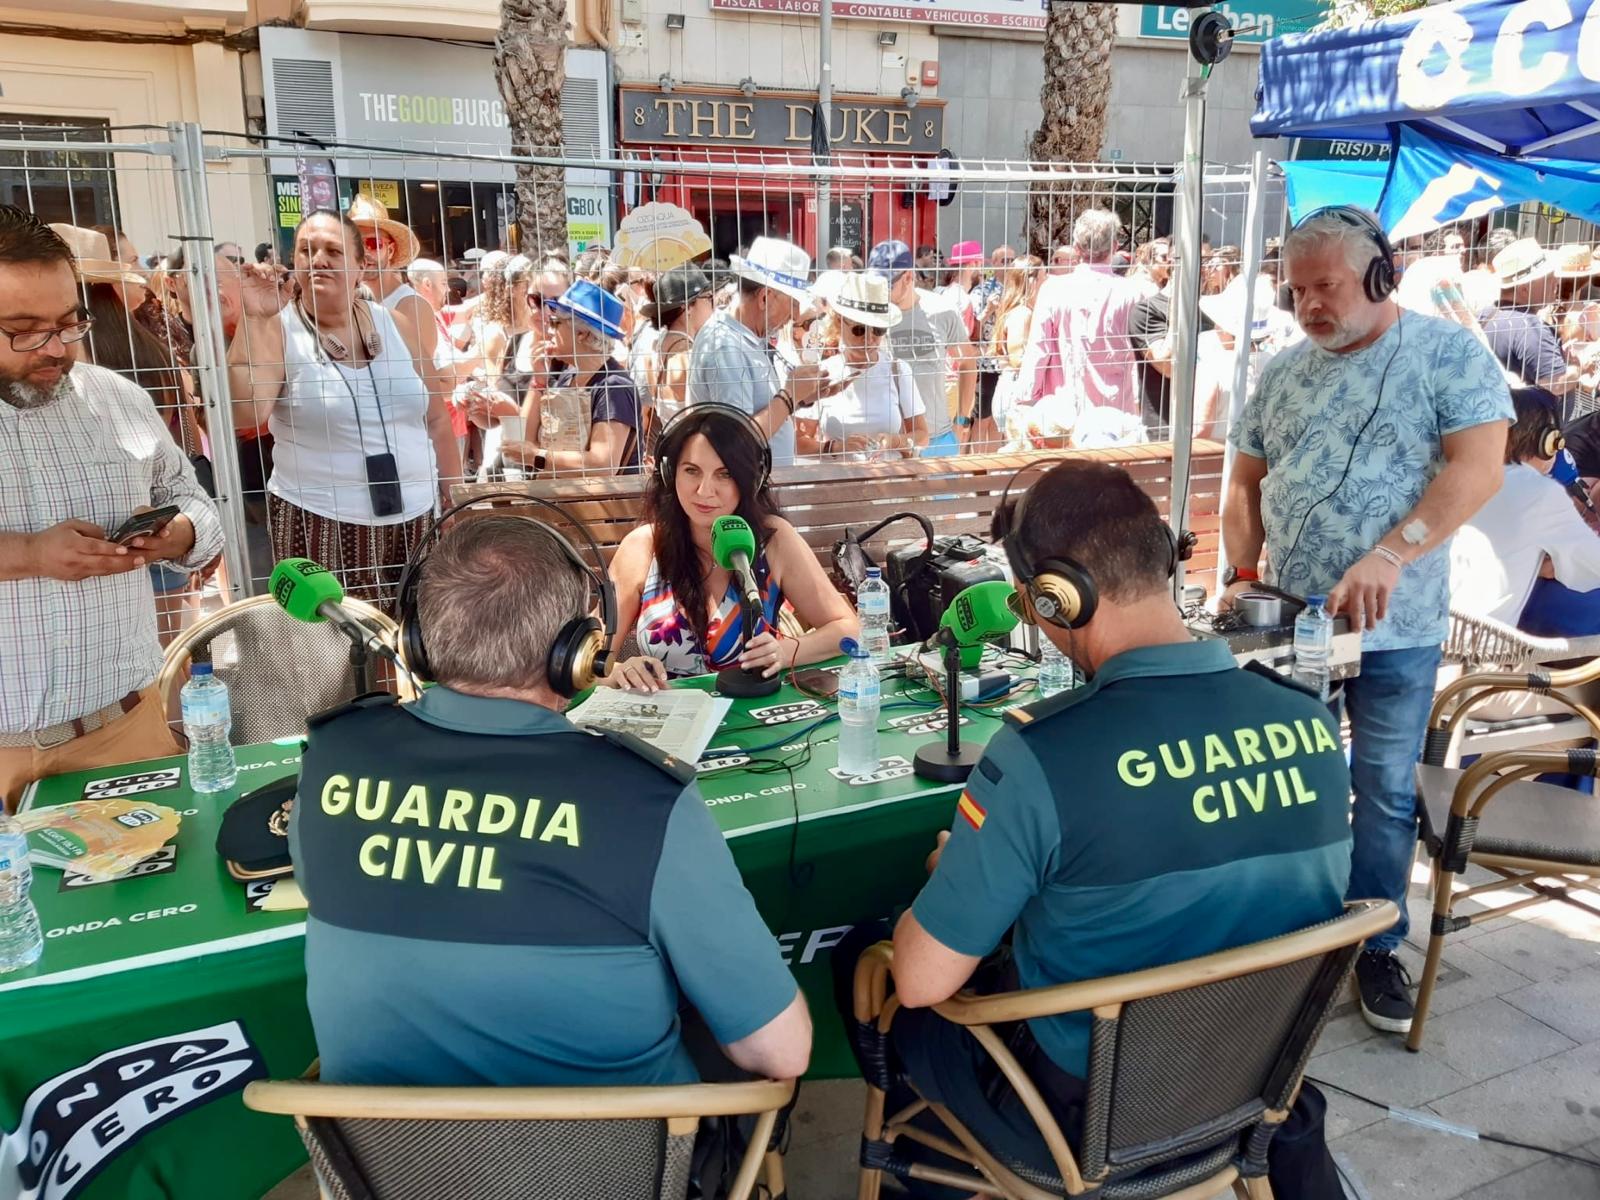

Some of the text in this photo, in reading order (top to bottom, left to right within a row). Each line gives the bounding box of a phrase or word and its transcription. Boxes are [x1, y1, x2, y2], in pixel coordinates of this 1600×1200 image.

[778, 1, 836, 14] LABOR
[849, 5, 912, 19] CONTABLE
[924, 11, 989, 24] VEHICULOS
[1157, 3, 1274, 37] Leban
[654, 98, 756, 140] THE
[784, 104, 913, 146] DUKE
[276, 181, 300, 196] ME
[279, 196, 301, 212] SIN
[761, 703, 813, 717] ONDA
[236, 760, 277, 772] NDA
[1117, 718, 1337, 787] GUARDIA
[98, 773, 168, 788] ONDA
[704, 783, 807, 807] ONDA CERO
[1192, 767, 1317, 823] CIVIL
[320, 774, 580, 848] GUARDIA
[358, 834, 503, 891] CIVIL
[45, 903, 199, 939] ONDA CERO
